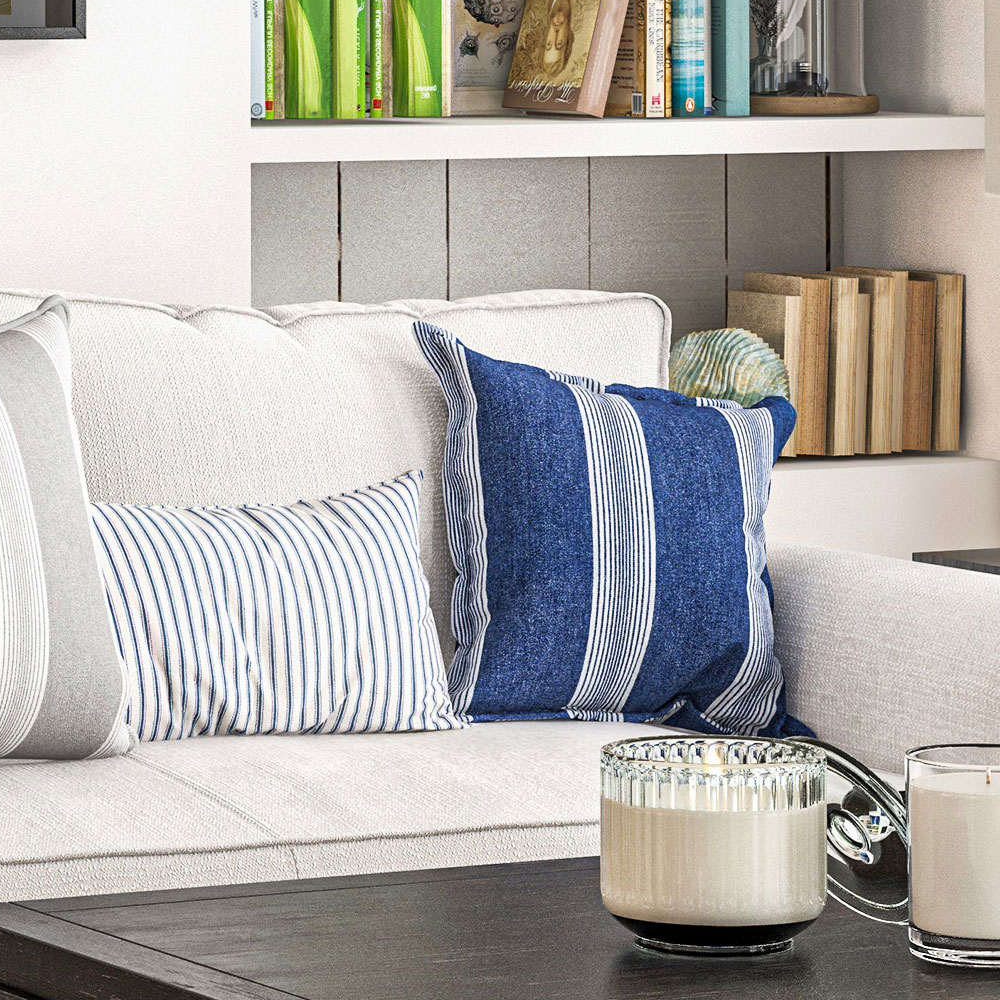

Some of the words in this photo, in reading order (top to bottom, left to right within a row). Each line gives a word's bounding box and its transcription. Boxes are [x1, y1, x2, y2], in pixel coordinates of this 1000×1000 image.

[655, 8, 663, 25] THE
[655, 28, 664, 82] CARIBBEAN
[508, 77, 555, 103] Professor
